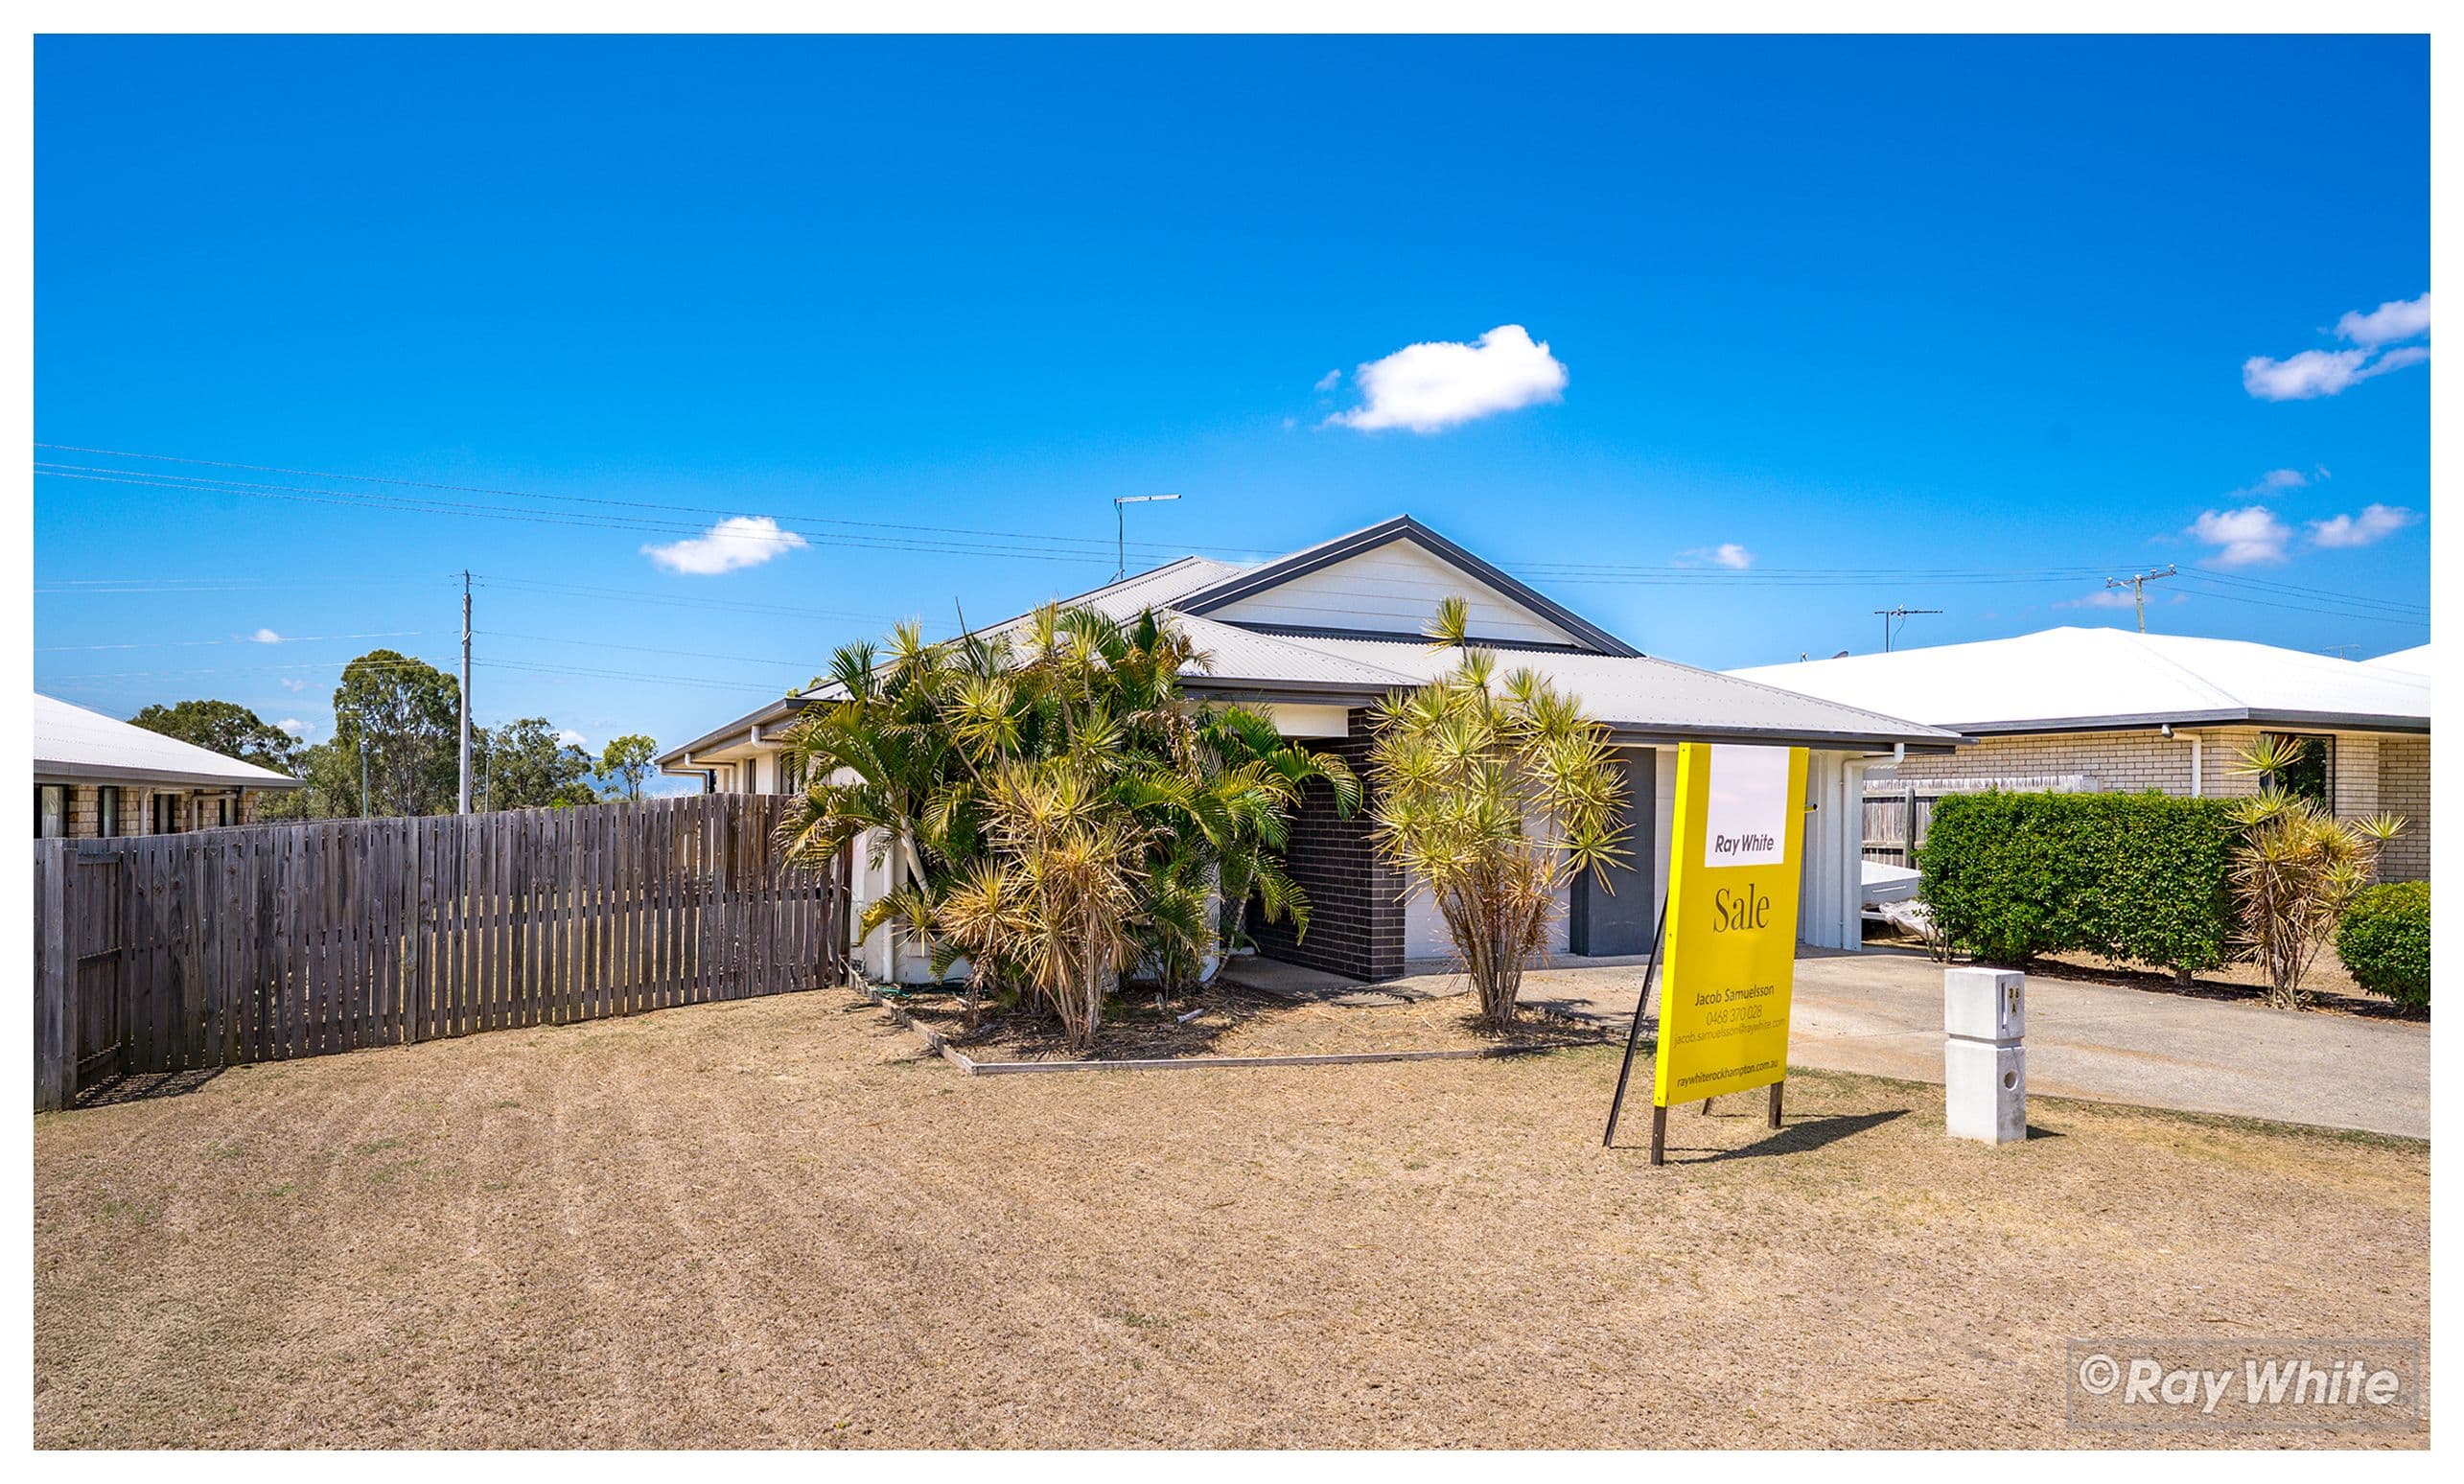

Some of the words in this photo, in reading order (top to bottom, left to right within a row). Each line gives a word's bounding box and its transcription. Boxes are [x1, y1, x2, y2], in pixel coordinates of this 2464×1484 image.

[1715, 834, 1740, 856] Ray
[1741, 833, 1775, 852] White
[1713, 883, 1770, 933] Sale
[1695, 990, 1723, 1007] Jacob
[1724, 984, 1775, 1003] Samuelsson
[1707, 1009, 1729, 1026] 0468
[1730, 1006, 1746, 1023] 370
[1747, 1004, 1763, 1020] 028
[1677, 1059, 1778, 1088] raywhiterockhampton.com.au
